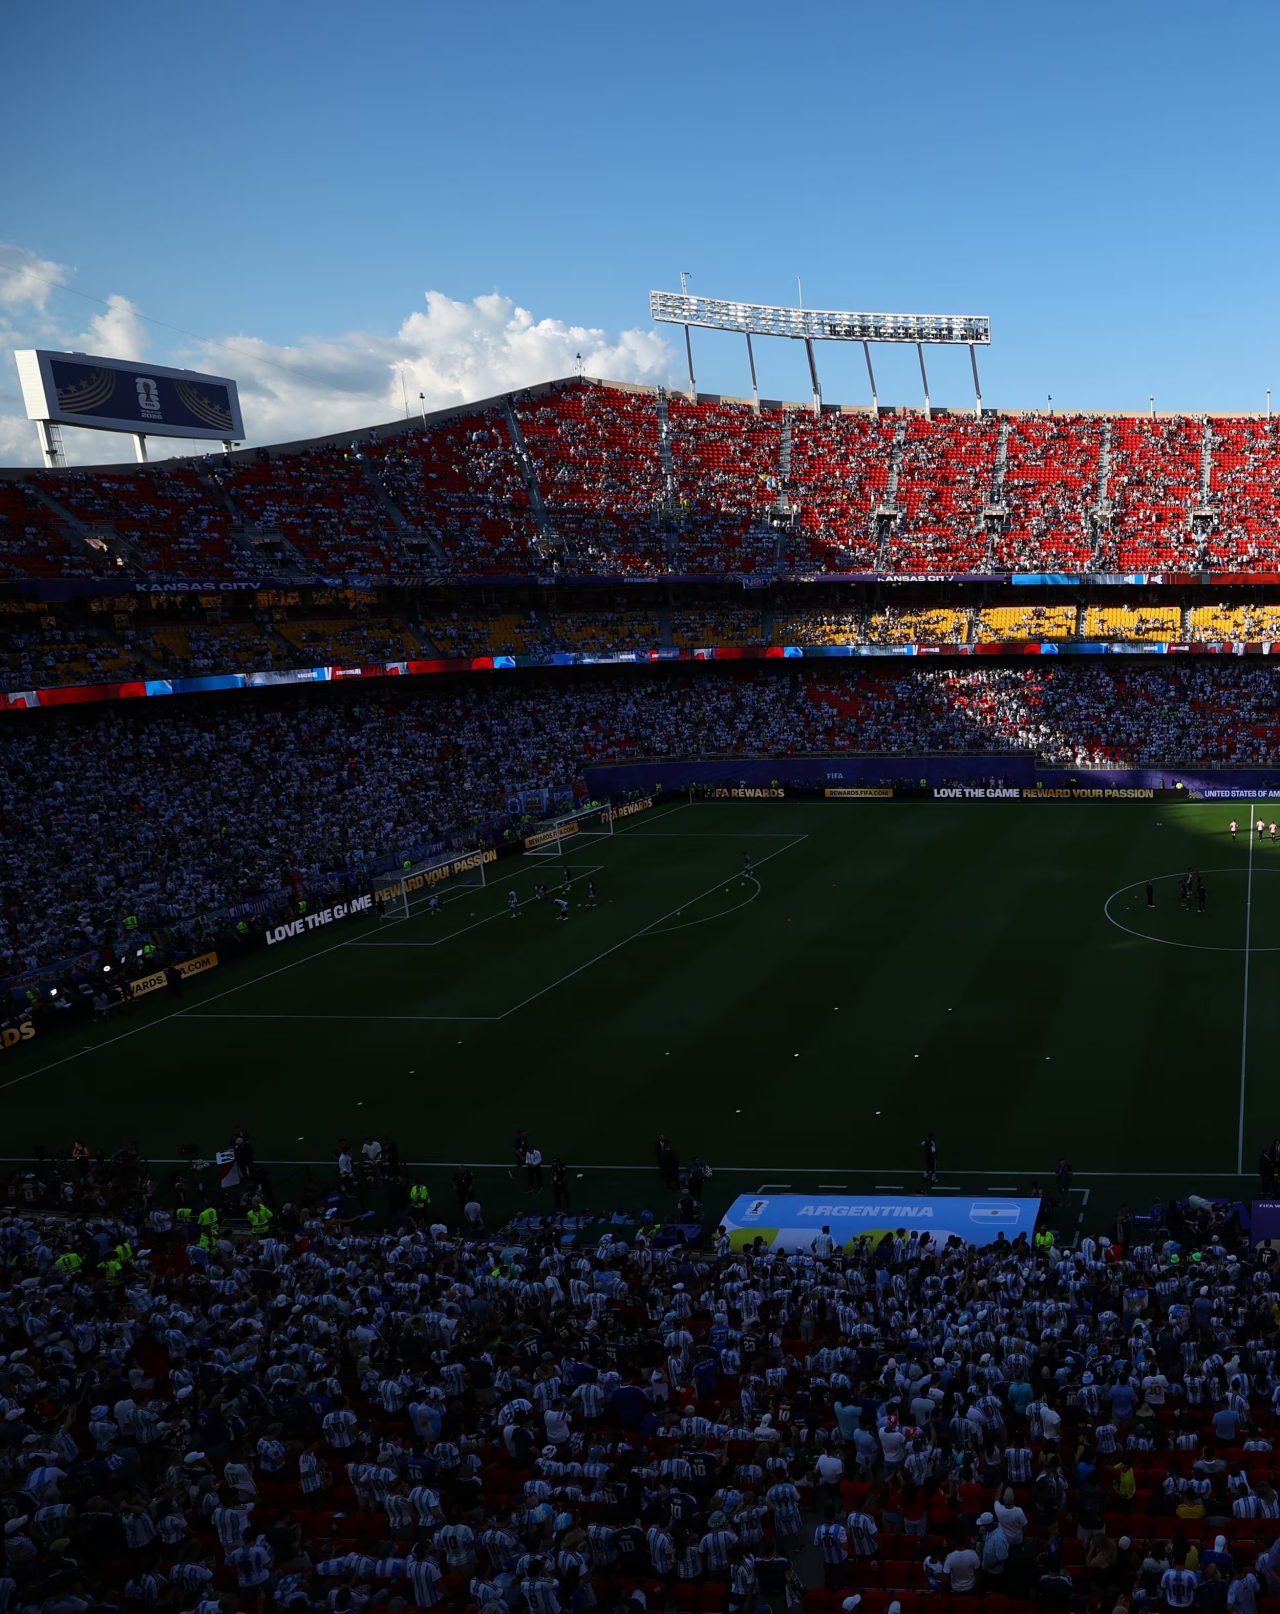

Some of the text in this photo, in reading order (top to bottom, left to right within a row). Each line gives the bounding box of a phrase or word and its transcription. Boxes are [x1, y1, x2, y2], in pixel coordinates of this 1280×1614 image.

[135, 582, 261, 592] KANSAS CITY
[826, 772, 844, 780] FIFA
[731, 788, 785, 798] REWARDS
[933, 788, 1020, 798] LOVE THE GAME
[1023, 788, 1154, 798] REWARD YOUR PASSION
[1204, 790, 1230, 798] UNITED
[1231, 790, 1257, 798] STATES
[1257, 790, 1267, 798] OF
[618, 798, 653, 817] REWARDS
[265, 921, 306, 946] LOVE
[305, 910, 334, 930] THE
[796, 1205, 934, 1217] ARGENTINA
[526, 1343, 539, 1357] 19
[744, 1341, 756, 1352] 23
[778, 1410, 790, 1422] 10
[693, 1464, 706, 1476] 10
[670, 1505, 682, 1519] 10
[445, 1536, 457, 1549] 10
[621, 1540, 634, 1552] 10
